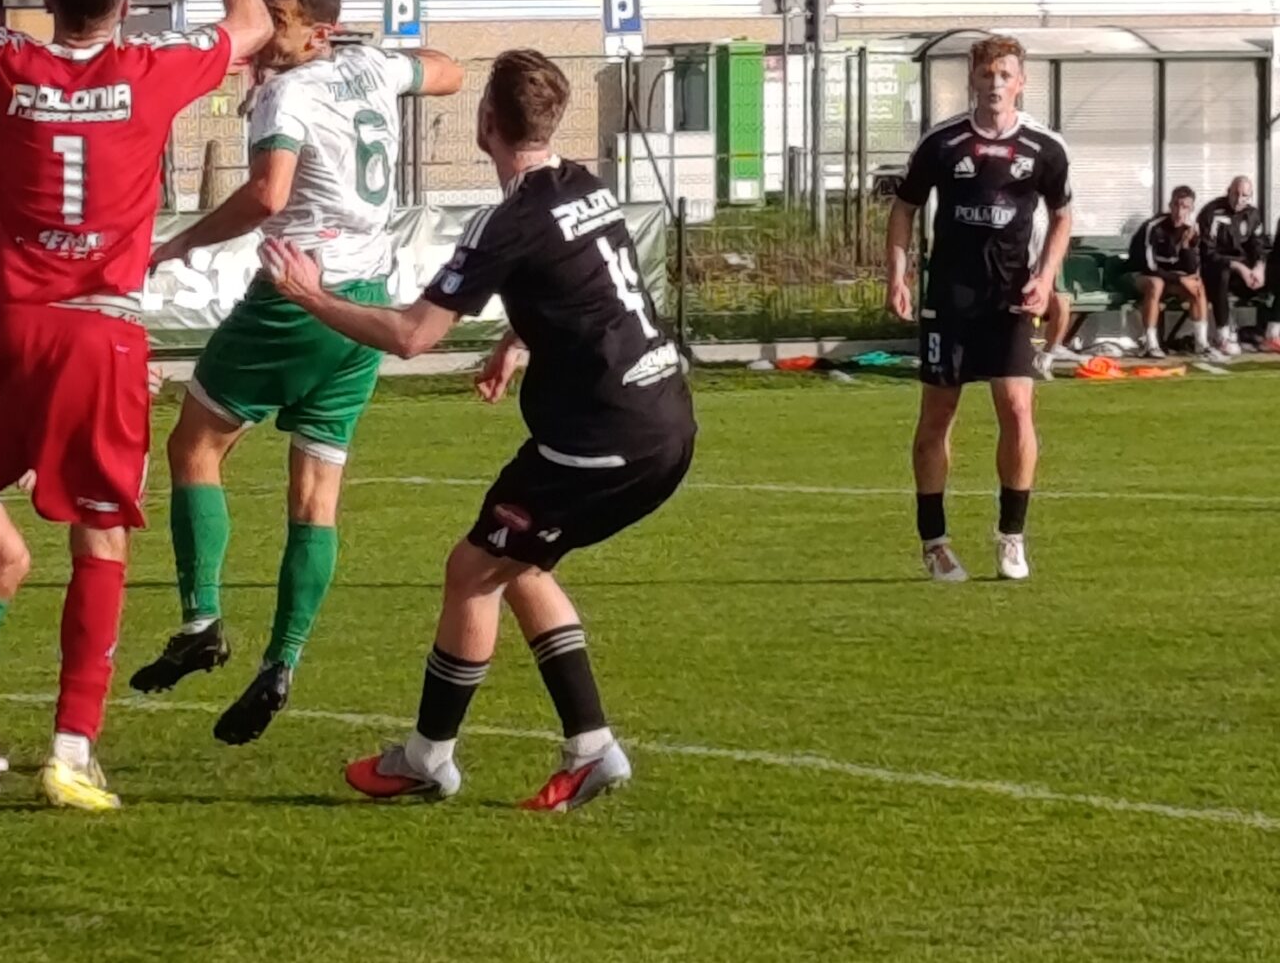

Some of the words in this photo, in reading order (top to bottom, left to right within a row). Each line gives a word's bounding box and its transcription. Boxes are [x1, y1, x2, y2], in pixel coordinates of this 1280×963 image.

[6, 83, 132, 116] POLONIA
[52, 135, 84, 226] 1
[352, 108, 390, 207] 6
